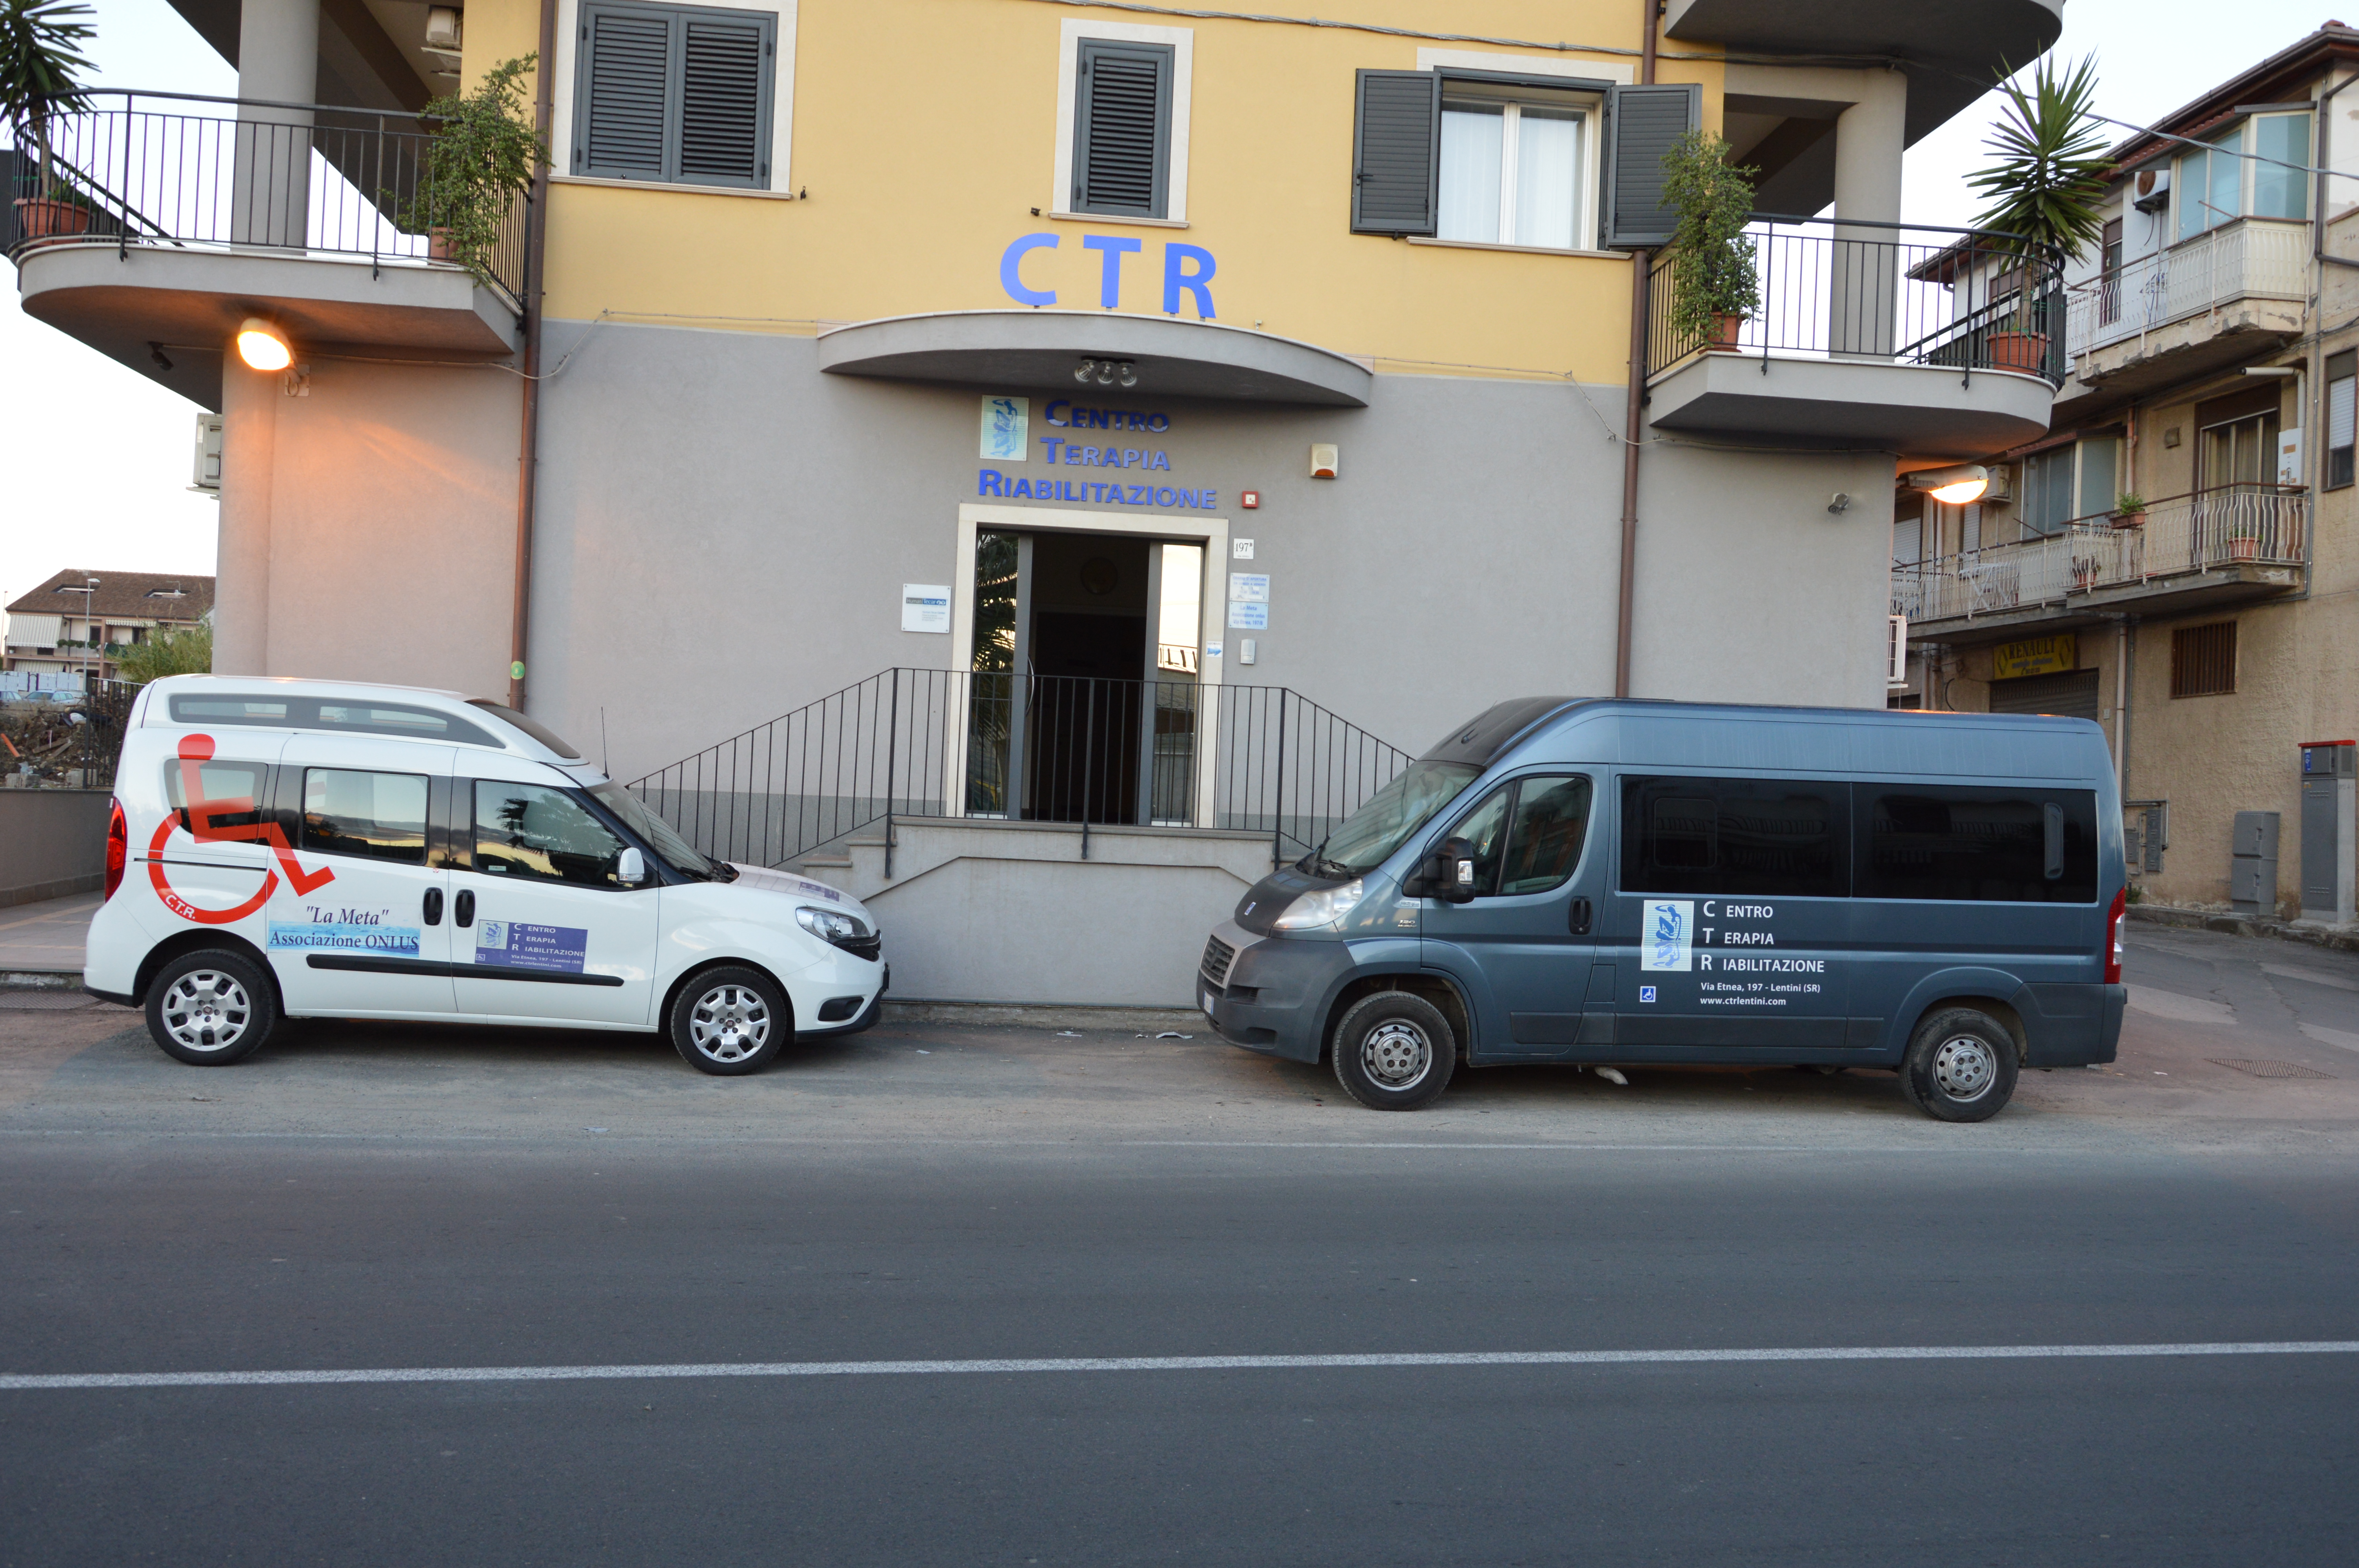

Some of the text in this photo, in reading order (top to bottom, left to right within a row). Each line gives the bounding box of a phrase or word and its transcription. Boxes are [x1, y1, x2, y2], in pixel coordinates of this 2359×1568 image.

[1000, 232, 1216, 319] CTR
[1045, 400, 1169, 433] CENTRO
[1040, 437, 1170, 471] TERAPIA
[979, 469, 1217, 509] RIABILITAZIONE
[2009, 638, 2056, 659] RENAULT
[165, 895, 196, 919] C.T.R.
[1726, 905, 1773, 918] ENTRO
[337, 908, 389, 926] Meta"
[269, 931, 418, 950] Associazione ONLUS
[1724, 932, 1774, 945] ERAPIA
[525, 946, 585, 957] IABILITAZIONE
[1723, 958, 1825, 973] IABILITAZIONE
[1701, 982, 1715, 991] Via
[1717, 982, 1745, 992] Etnea,
[1770, 983, 1801, 992] Lentini
[1803, 984, 1820, 993] (SR)
[1700, 996, 1787, 1005] www.ctrlentini.com
